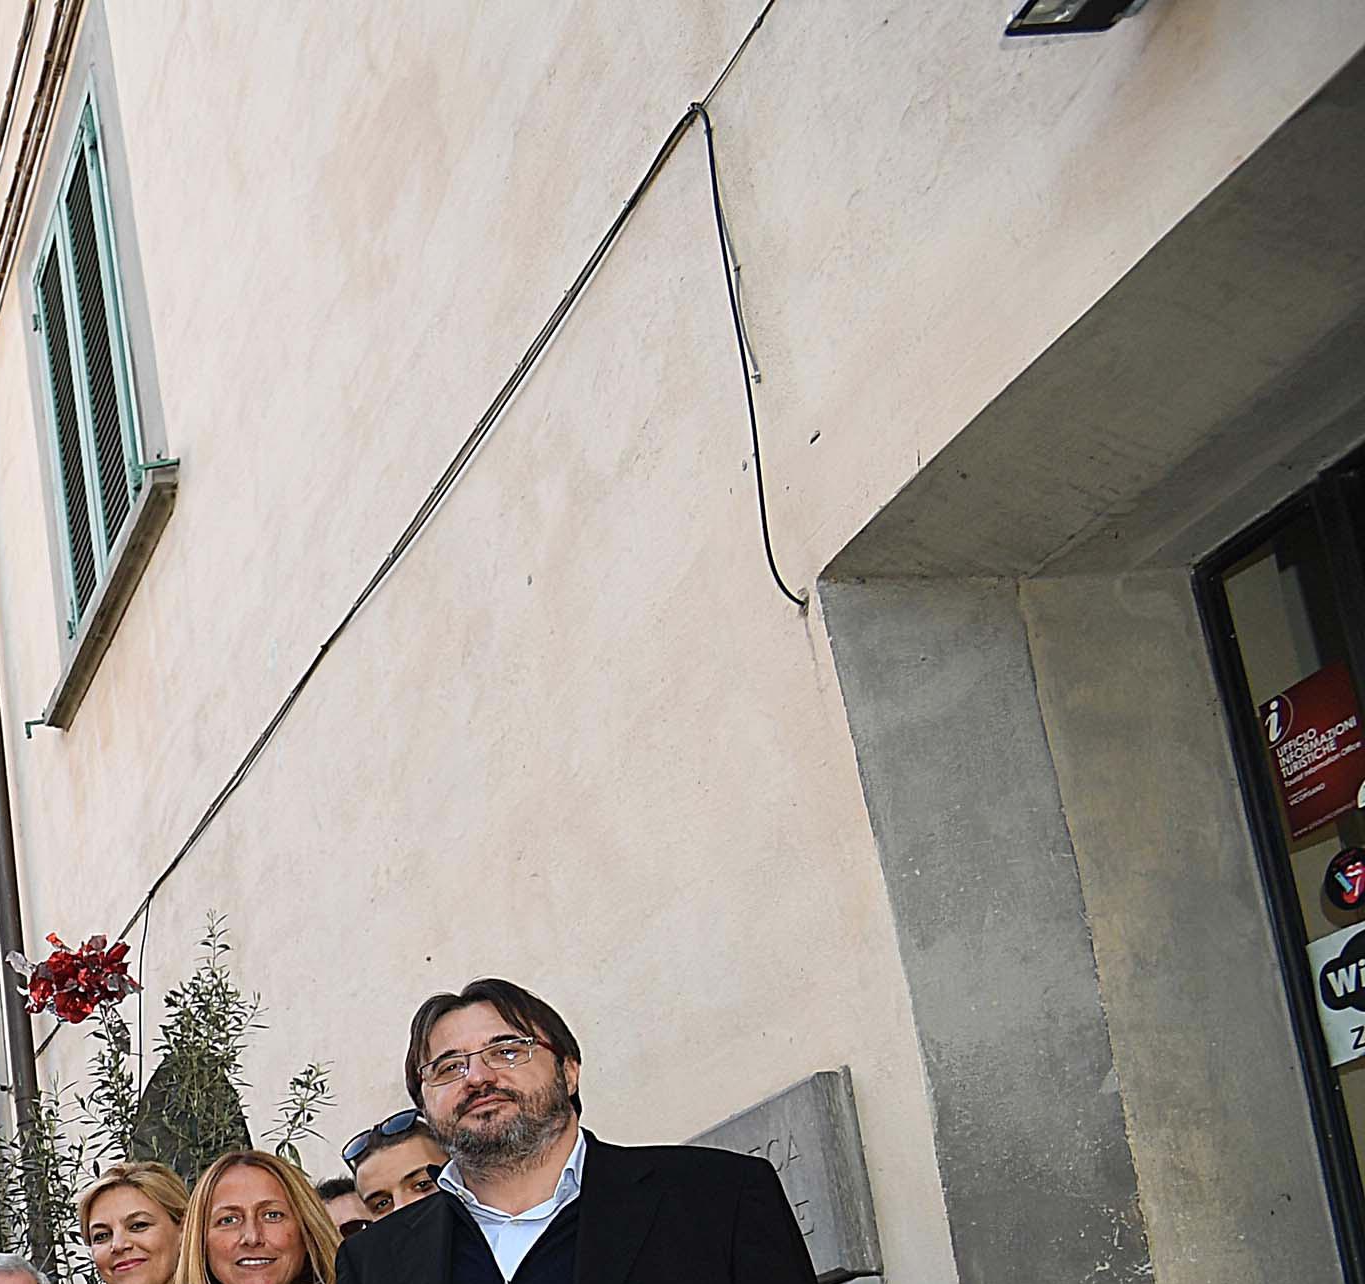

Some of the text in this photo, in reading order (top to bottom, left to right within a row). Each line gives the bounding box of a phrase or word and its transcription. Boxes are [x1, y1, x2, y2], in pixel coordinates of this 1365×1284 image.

[1276, 728, 1317, 758] UFFICIO
[1279, 715, 1358, 768] INFORMAZIONI
[1281, 738, 1338, 779] TURISTICHE
